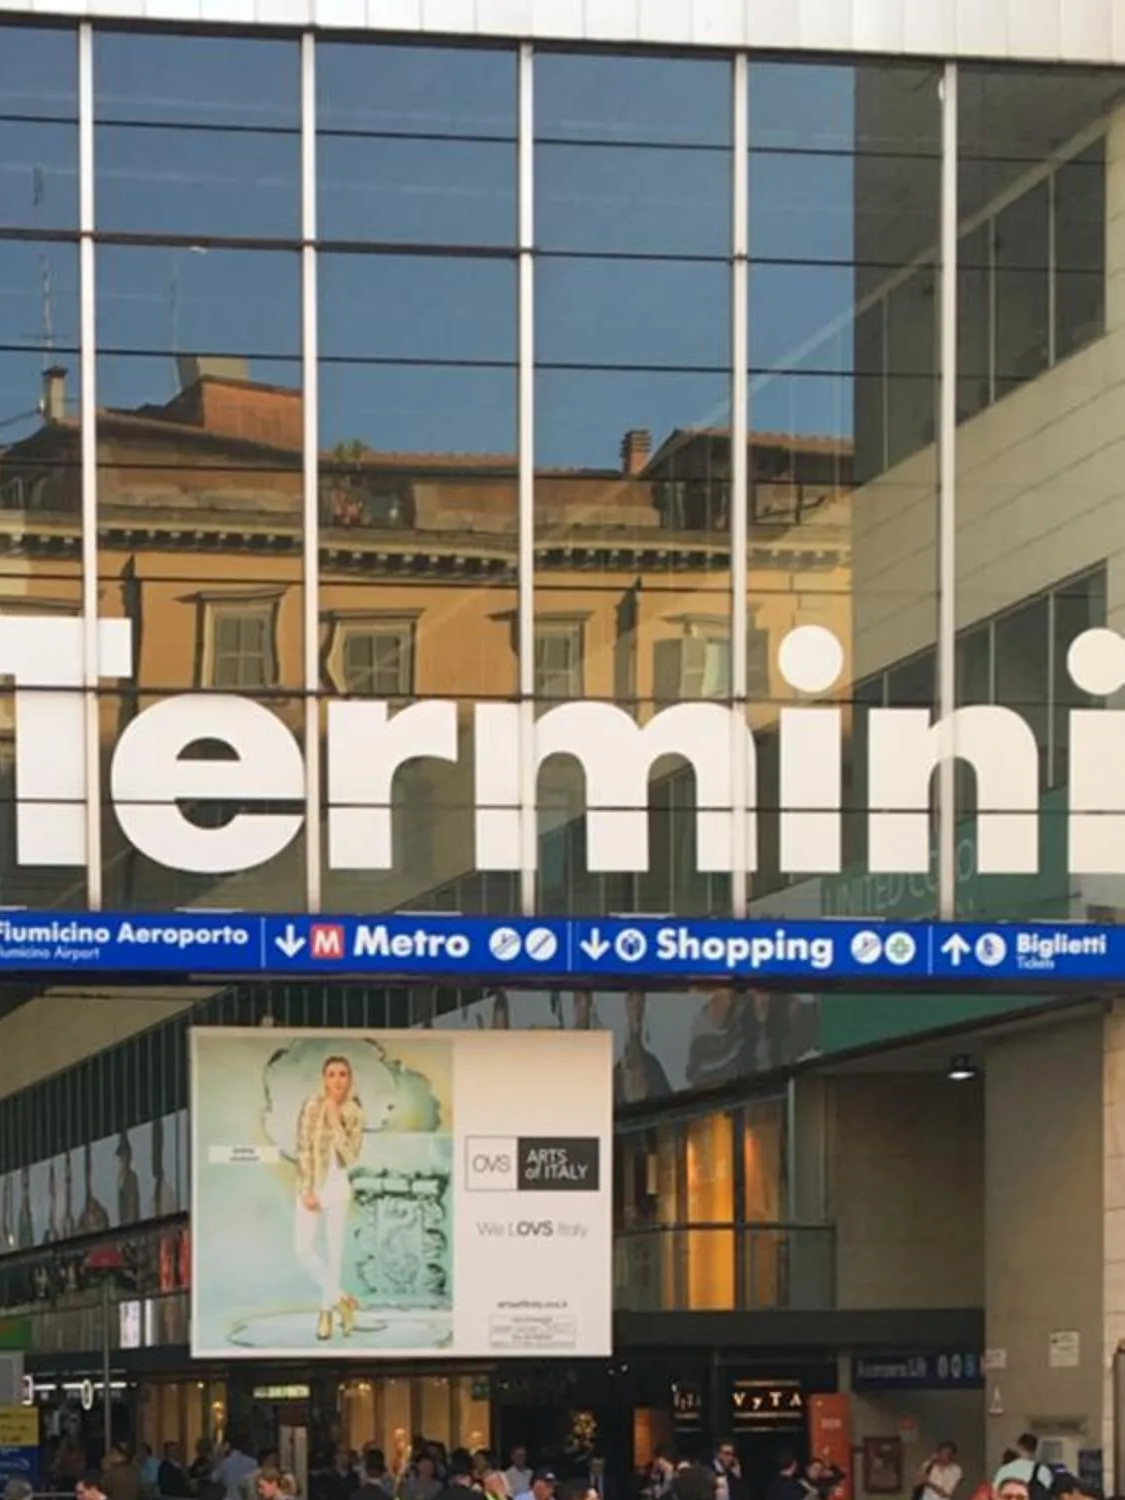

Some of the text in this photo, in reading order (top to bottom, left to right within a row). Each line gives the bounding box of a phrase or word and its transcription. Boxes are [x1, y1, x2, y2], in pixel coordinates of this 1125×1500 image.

[117, 922, 250, 949] Aeroporto
[315, 926, 471, 957] M Metro
[1016, 932, 1107, 958] Biglietti
[53, 945, 100, 961] Airport
[656, 928, 833, 968] Shopping
[472, 1153, 511, 1174] OVS
[526, 1148, 568, 1165] ARTS
[524, 1161, 589, 1180] of ITALY
[476, 1221, 505, 1236] We
[508, 1220, 554, 1237] LOVS
